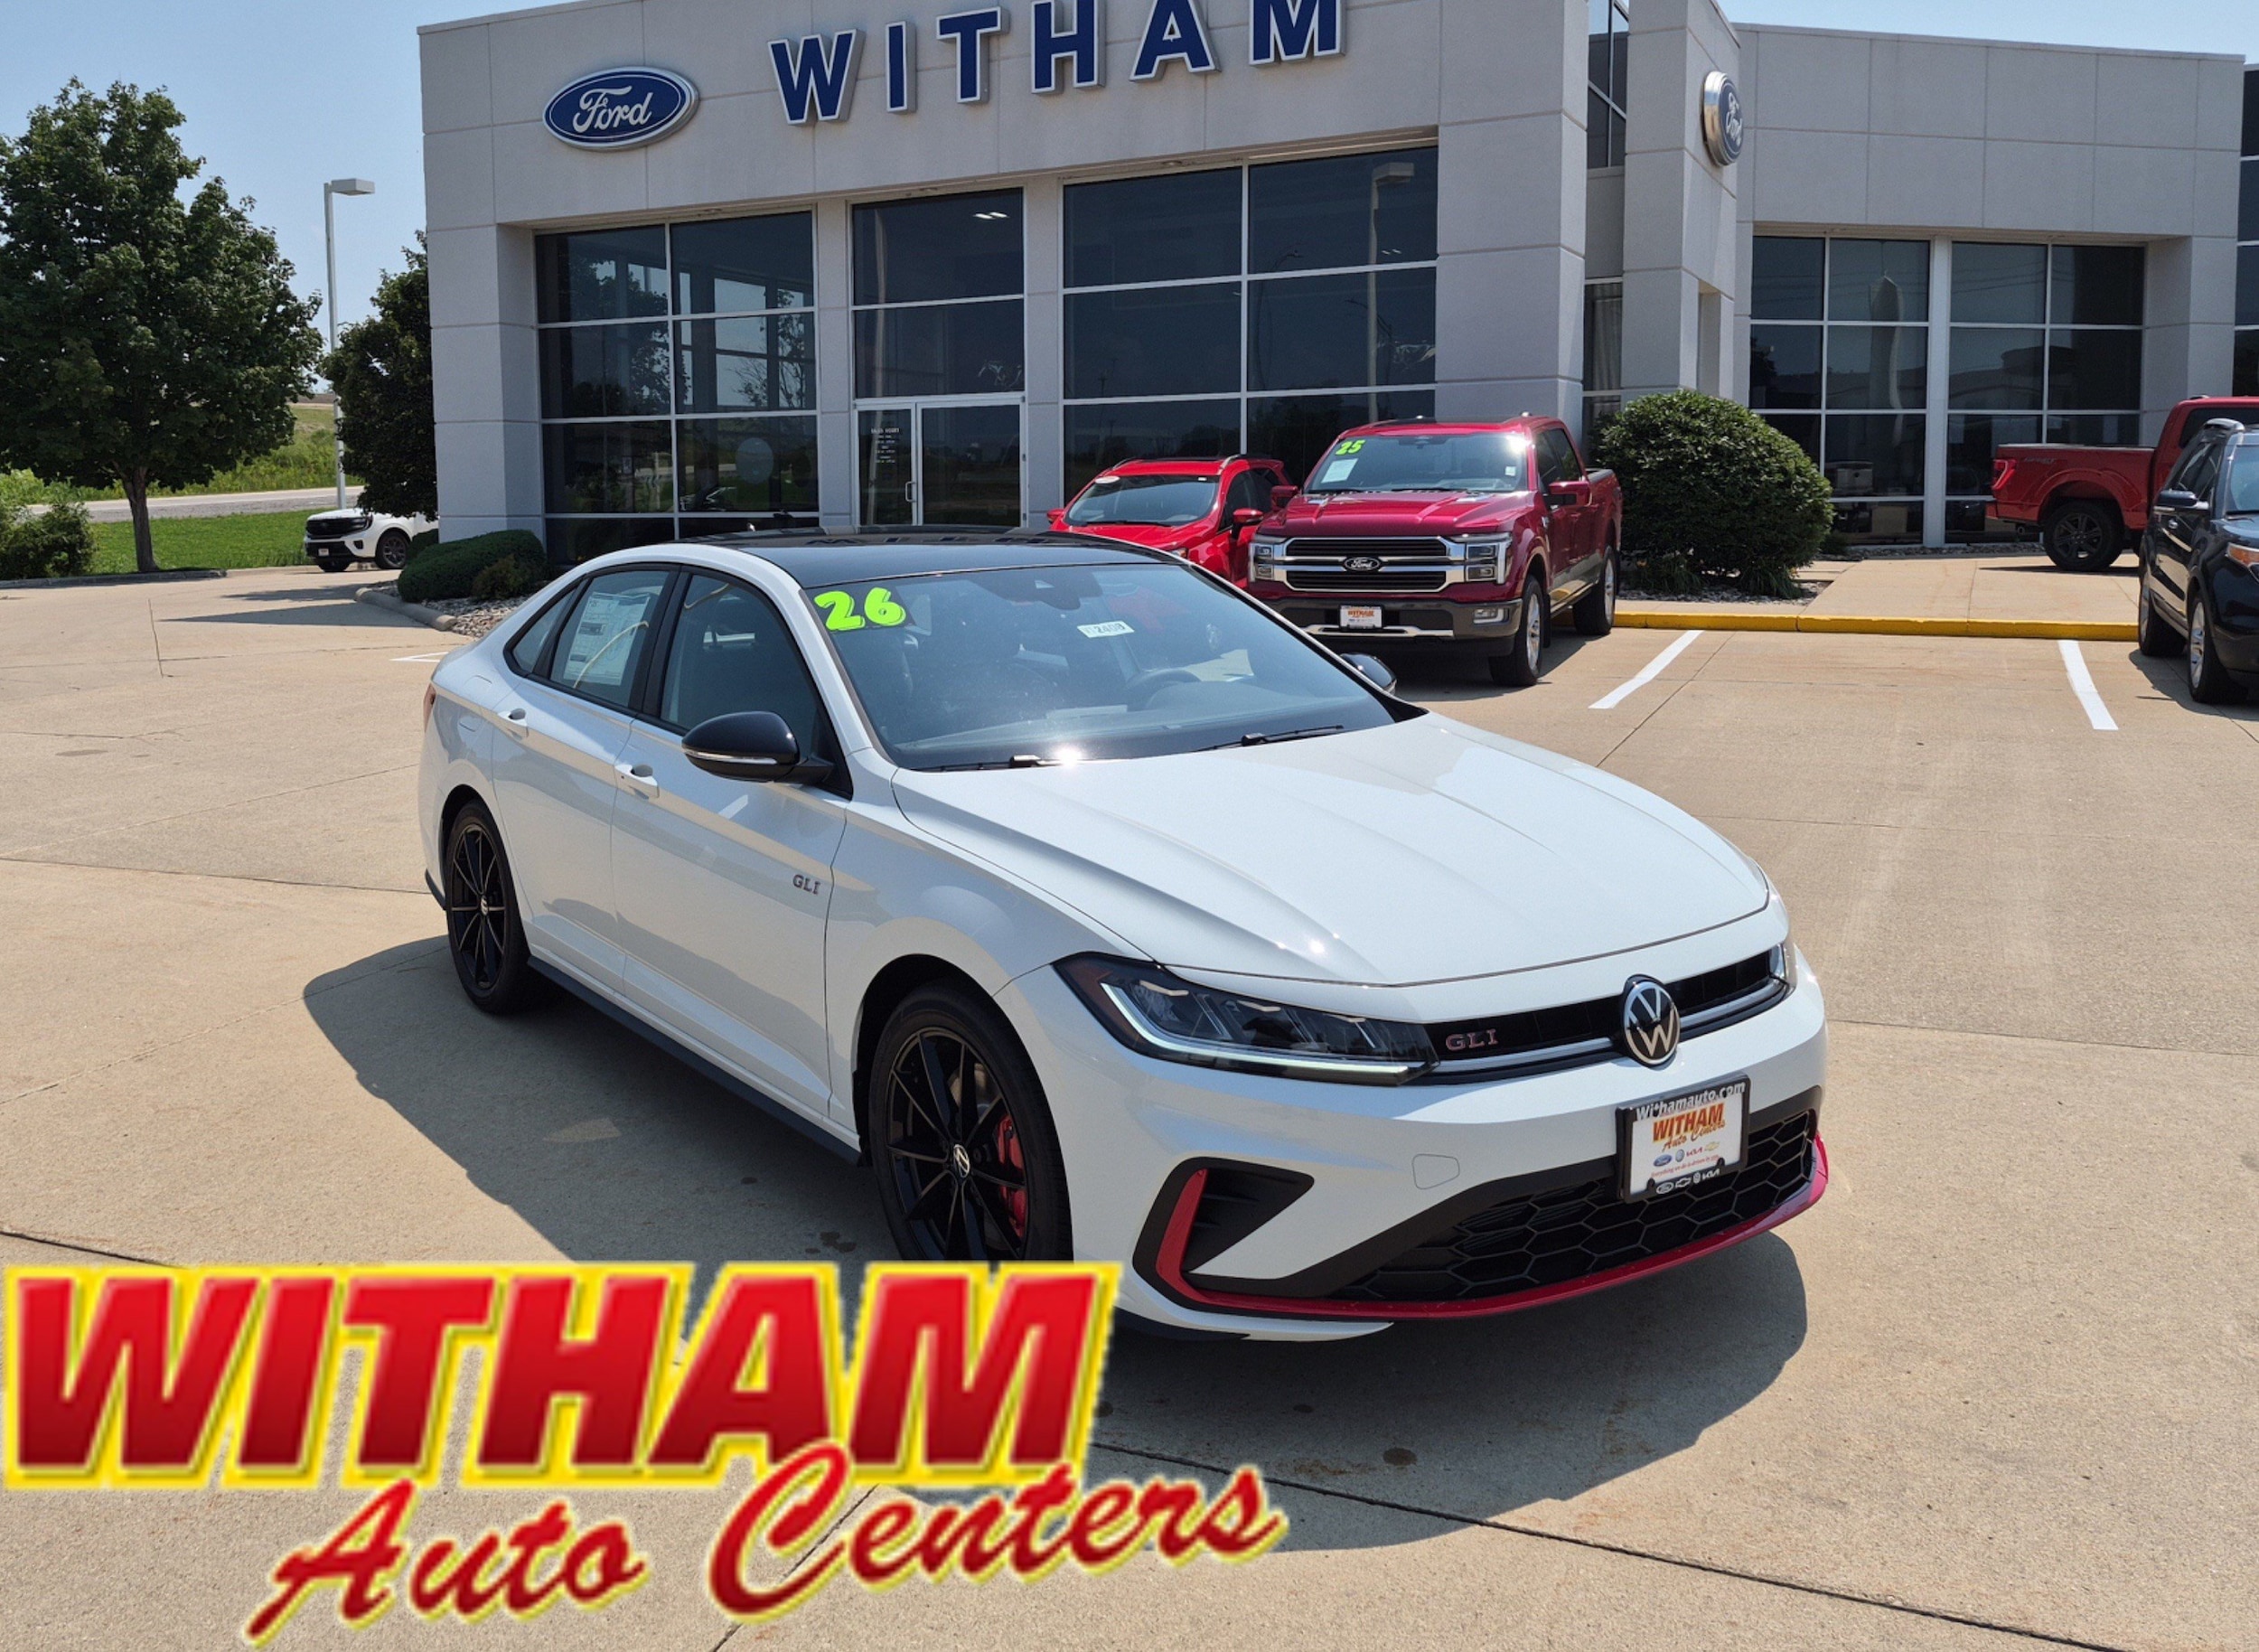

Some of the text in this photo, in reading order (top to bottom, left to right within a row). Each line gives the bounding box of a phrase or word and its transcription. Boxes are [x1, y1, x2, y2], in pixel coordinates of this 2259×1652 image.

[768, 0, 1344, 126] WITHAM
[572, 85, 653, 133] Ford
[1335, 439, 1366, 455] 25
[814, 587, 906, 631] 26
[792, 874, 820, 895] GLI
[1445, 1028, 1498, 1051] GLI
[1653, 1103, 1724, 1142] WITHAM
